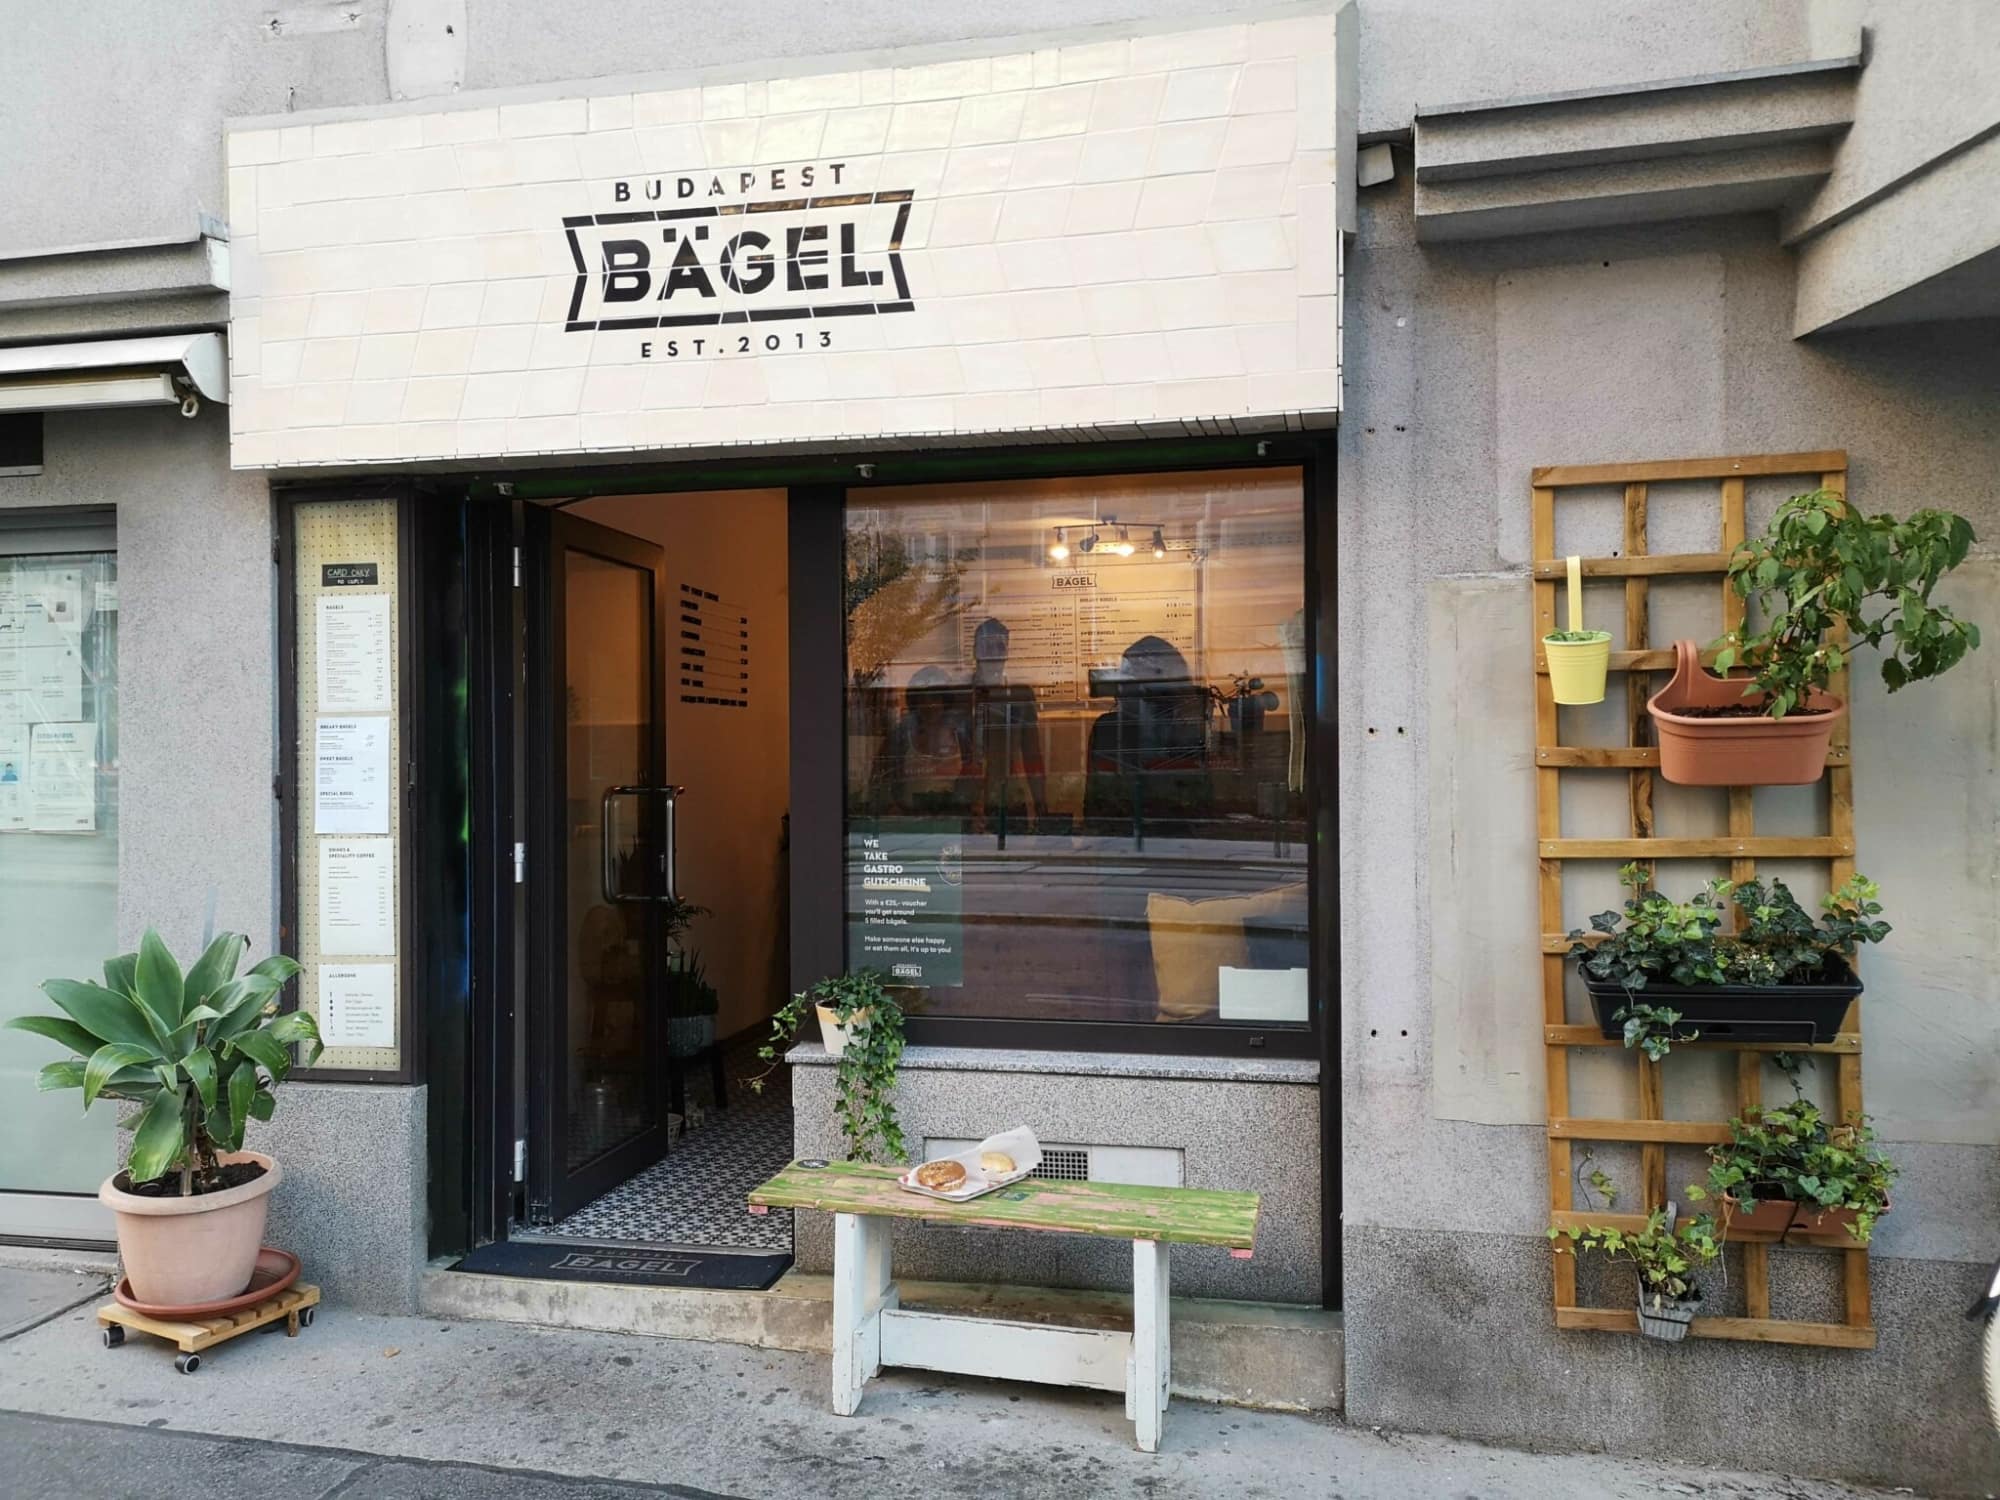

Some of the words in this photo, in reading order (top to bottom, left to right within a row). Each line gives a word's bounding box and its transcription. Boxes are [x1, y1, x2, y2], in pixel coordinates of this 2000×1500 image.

[614, 163, 846, 202] BUDAPEST
[600, 222, 884, 303] BÄGEL
[863, 839, 880, 848] WE
[863, 851, 889, 861] TAKE
[863, 864, 904, 874] GASTRO
[863, 877, 927, 887] GUTSCHEINE
[901, 899, 928, 907] voucher
[881, 909, 892, 917] get
[864, 935, 881, 943] Make
[925, 936, 946, 945] happy
